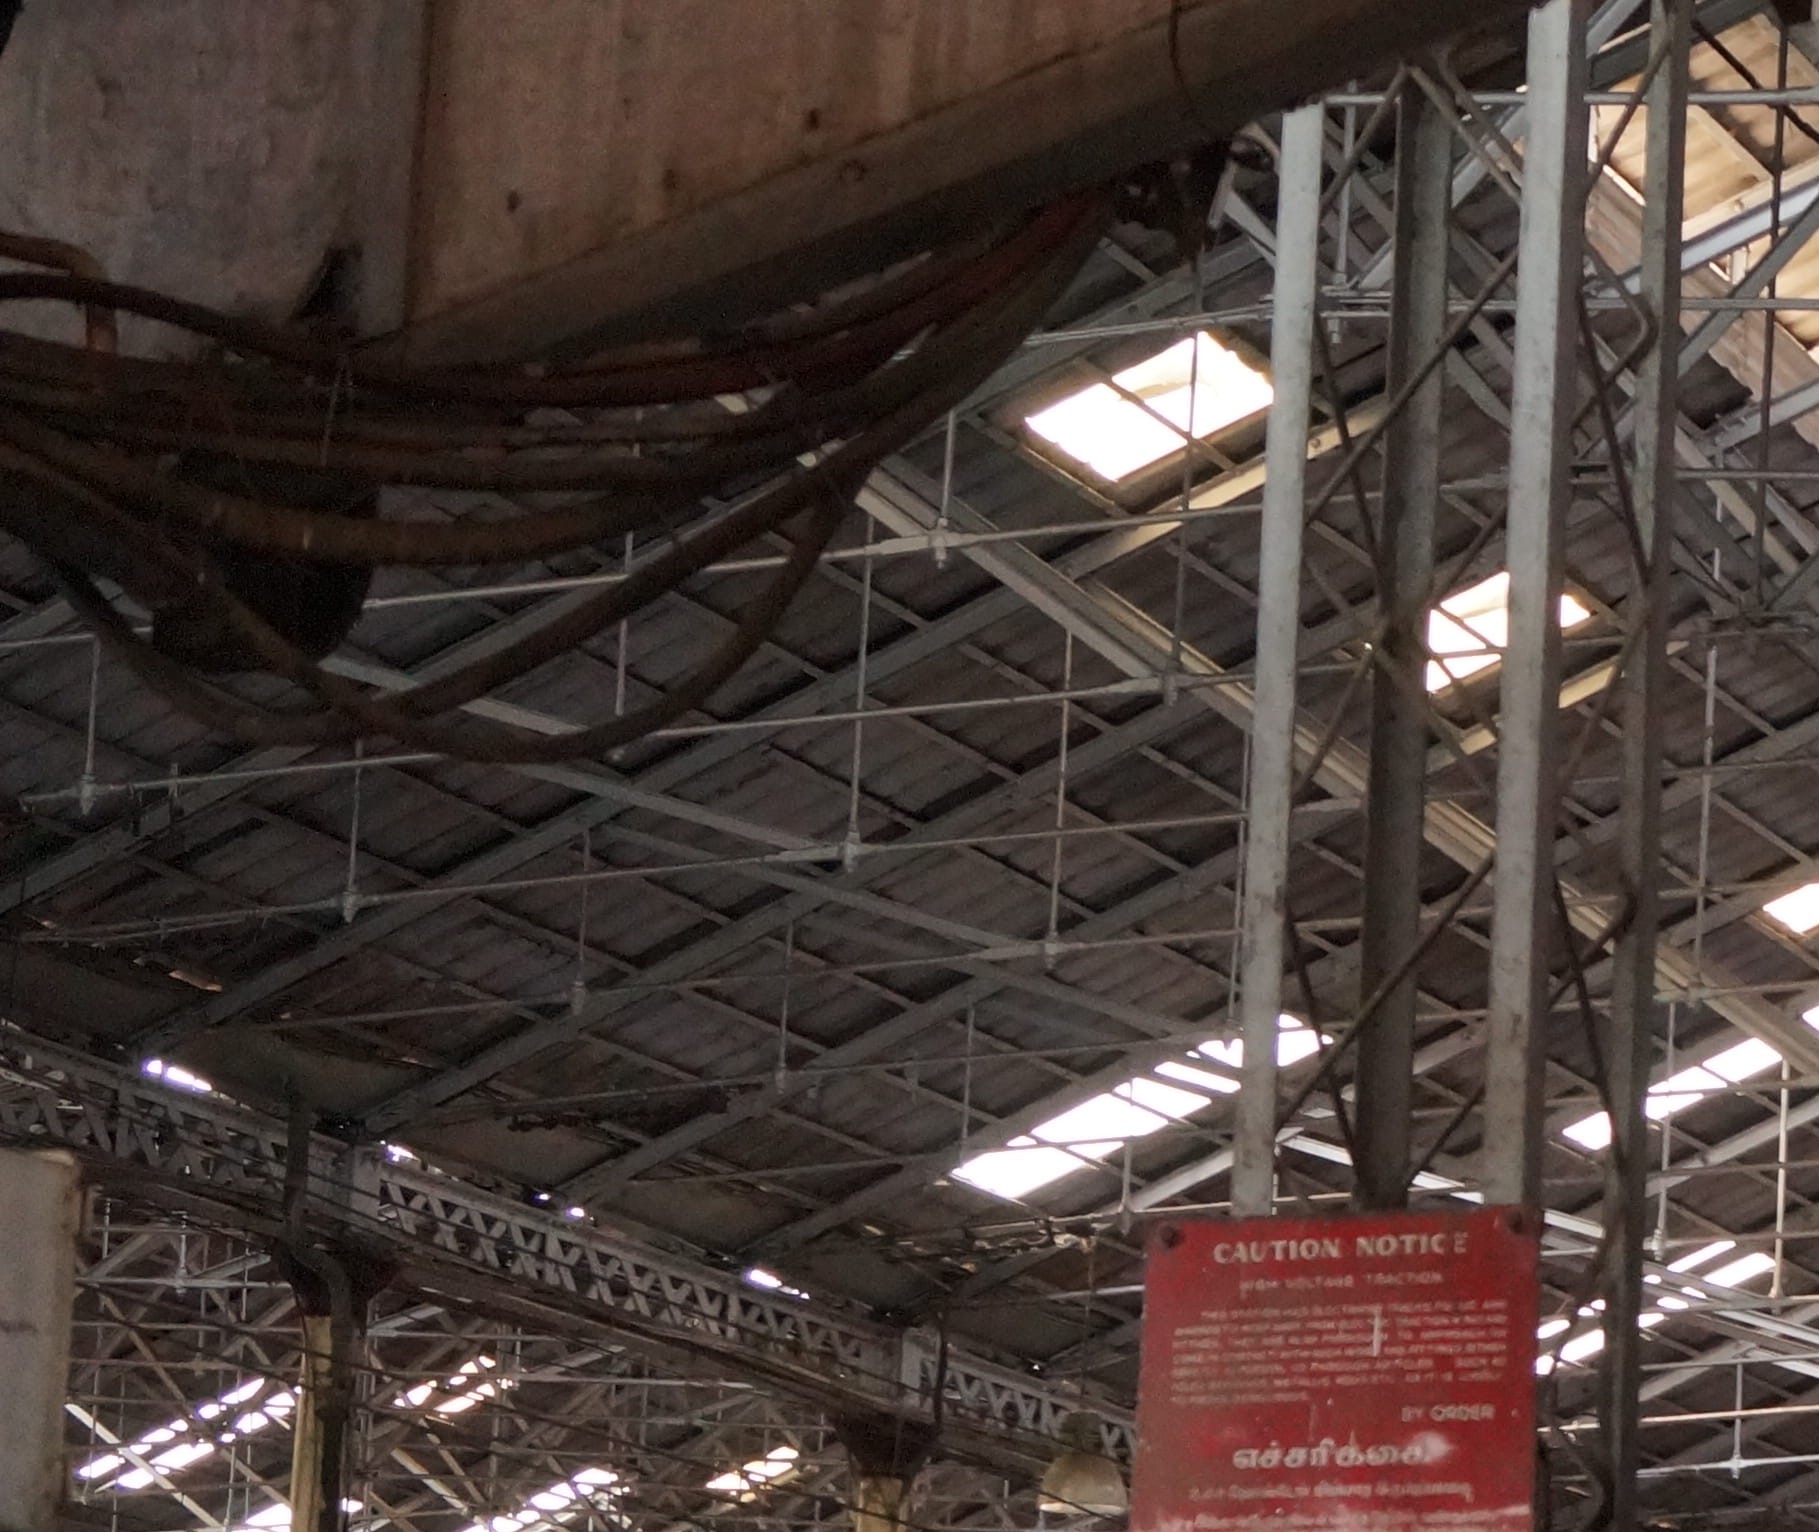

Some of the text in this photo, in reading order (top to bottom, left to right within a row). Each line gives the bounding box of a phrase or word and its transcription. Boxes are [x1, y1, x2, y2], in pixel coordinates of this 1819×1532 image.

[1213, 1231, 1469, 1264] CAUTION NOTICE
[1430, 1403, 1496, 1422] ORDER
